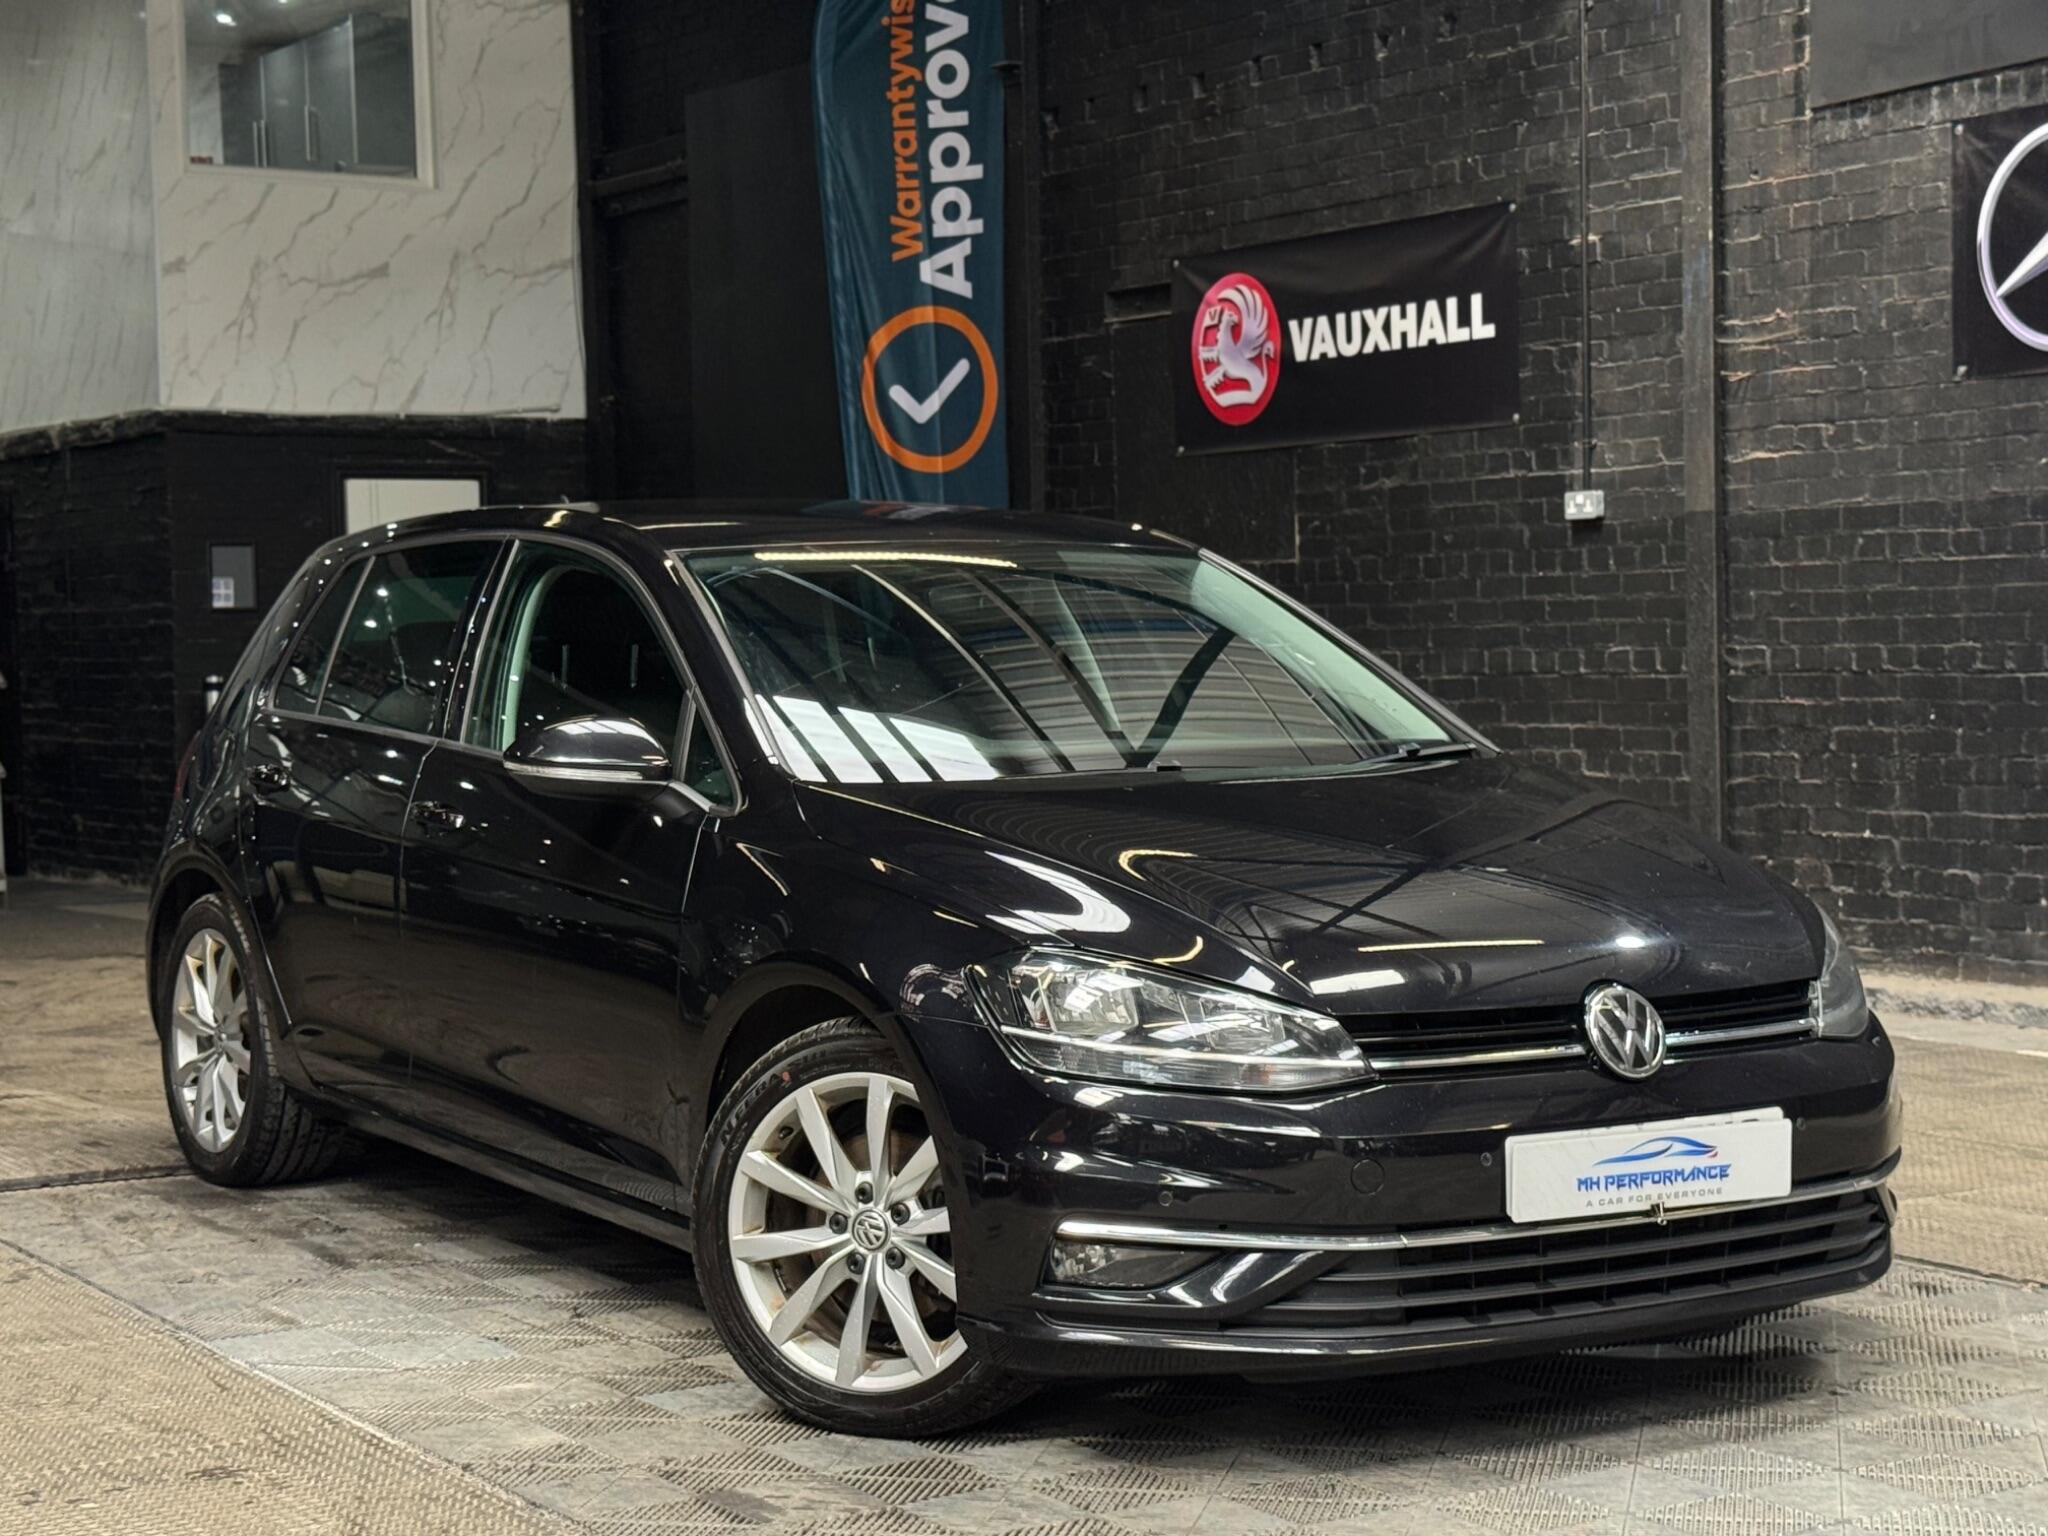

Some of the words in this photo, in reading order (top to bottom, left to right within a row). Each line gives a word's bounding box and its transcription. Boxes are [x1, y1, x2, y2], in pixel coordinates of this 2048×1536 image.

[919, 0, 984, 300] Approv
[1288, 293, 1496, 362] VAUXHALL
[1576, 1175, 1601, 1192] MH
[1604, 1163, 1732, 1192] PERFORMANCE
[1585, 1200, 1594, 1208] A
[1598, 1197, 1624, 1207] CAR
[1628, 1194, 1652, 1204] FOR
[1657, 1187, 1723, 1201] EVERYONE
